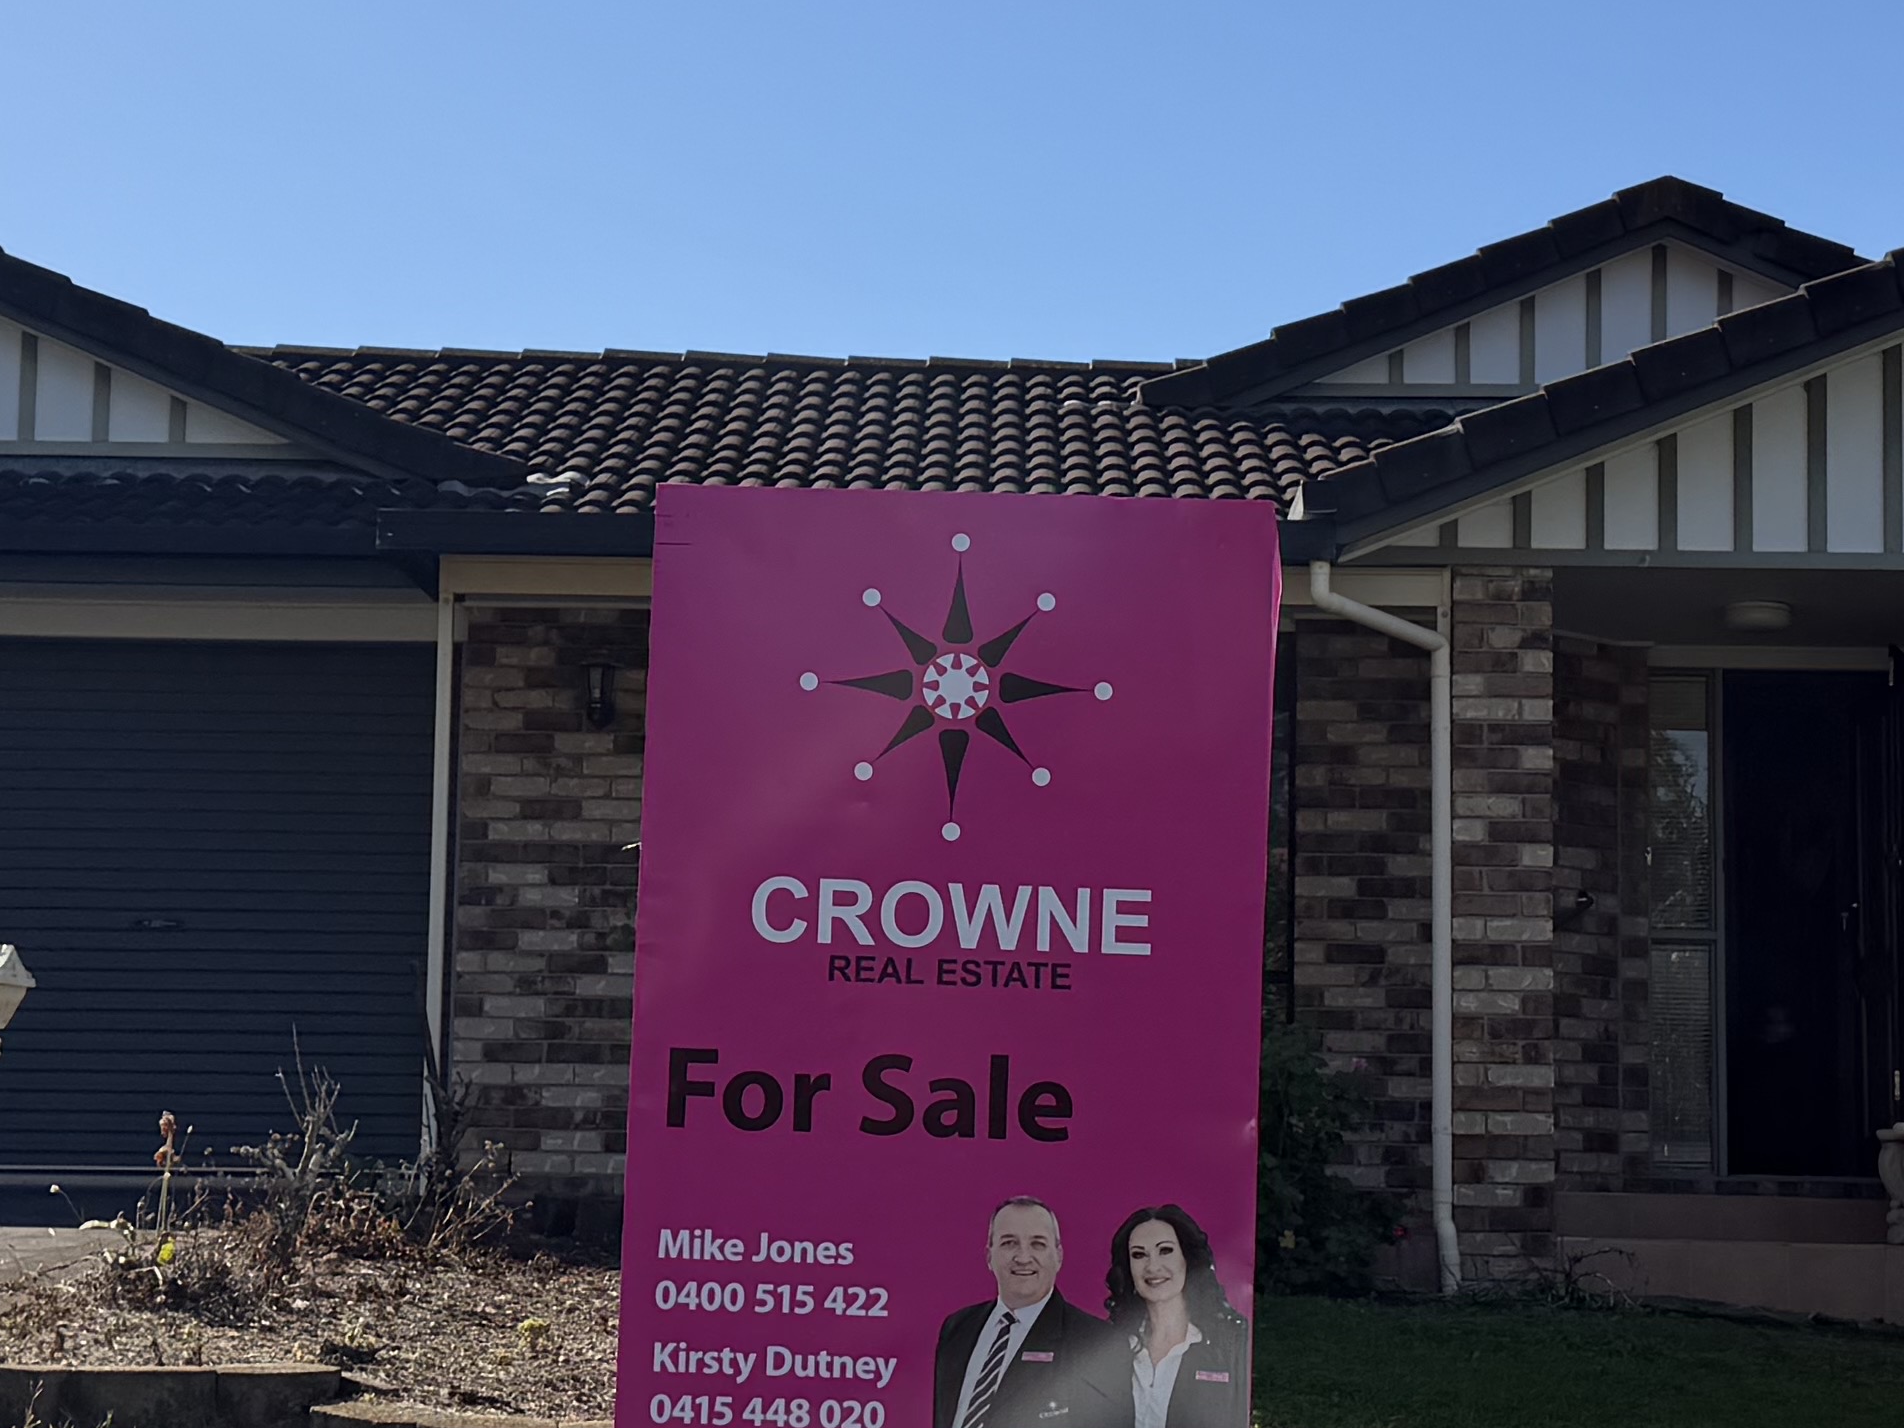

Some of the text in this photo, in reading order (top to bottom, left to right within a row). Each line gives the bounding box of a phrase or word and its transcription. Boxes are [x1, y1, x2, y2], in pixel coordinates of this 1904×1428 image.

[751, 875, 1153, 956] CROWNE
[828, 954, 1073, 991] REAL ESTATE
[666, 1047, 1074, 1143] For Sale
[657, 1228, 855, 1266] Mike Jones
[654, 1280, 890, 1317] 0400 515 422
[653, 1341, 898, 1389] Kirsty Dutney
[649, 1393, 733, 1426] 0415
[742, 1397, 811, 1428] 448
